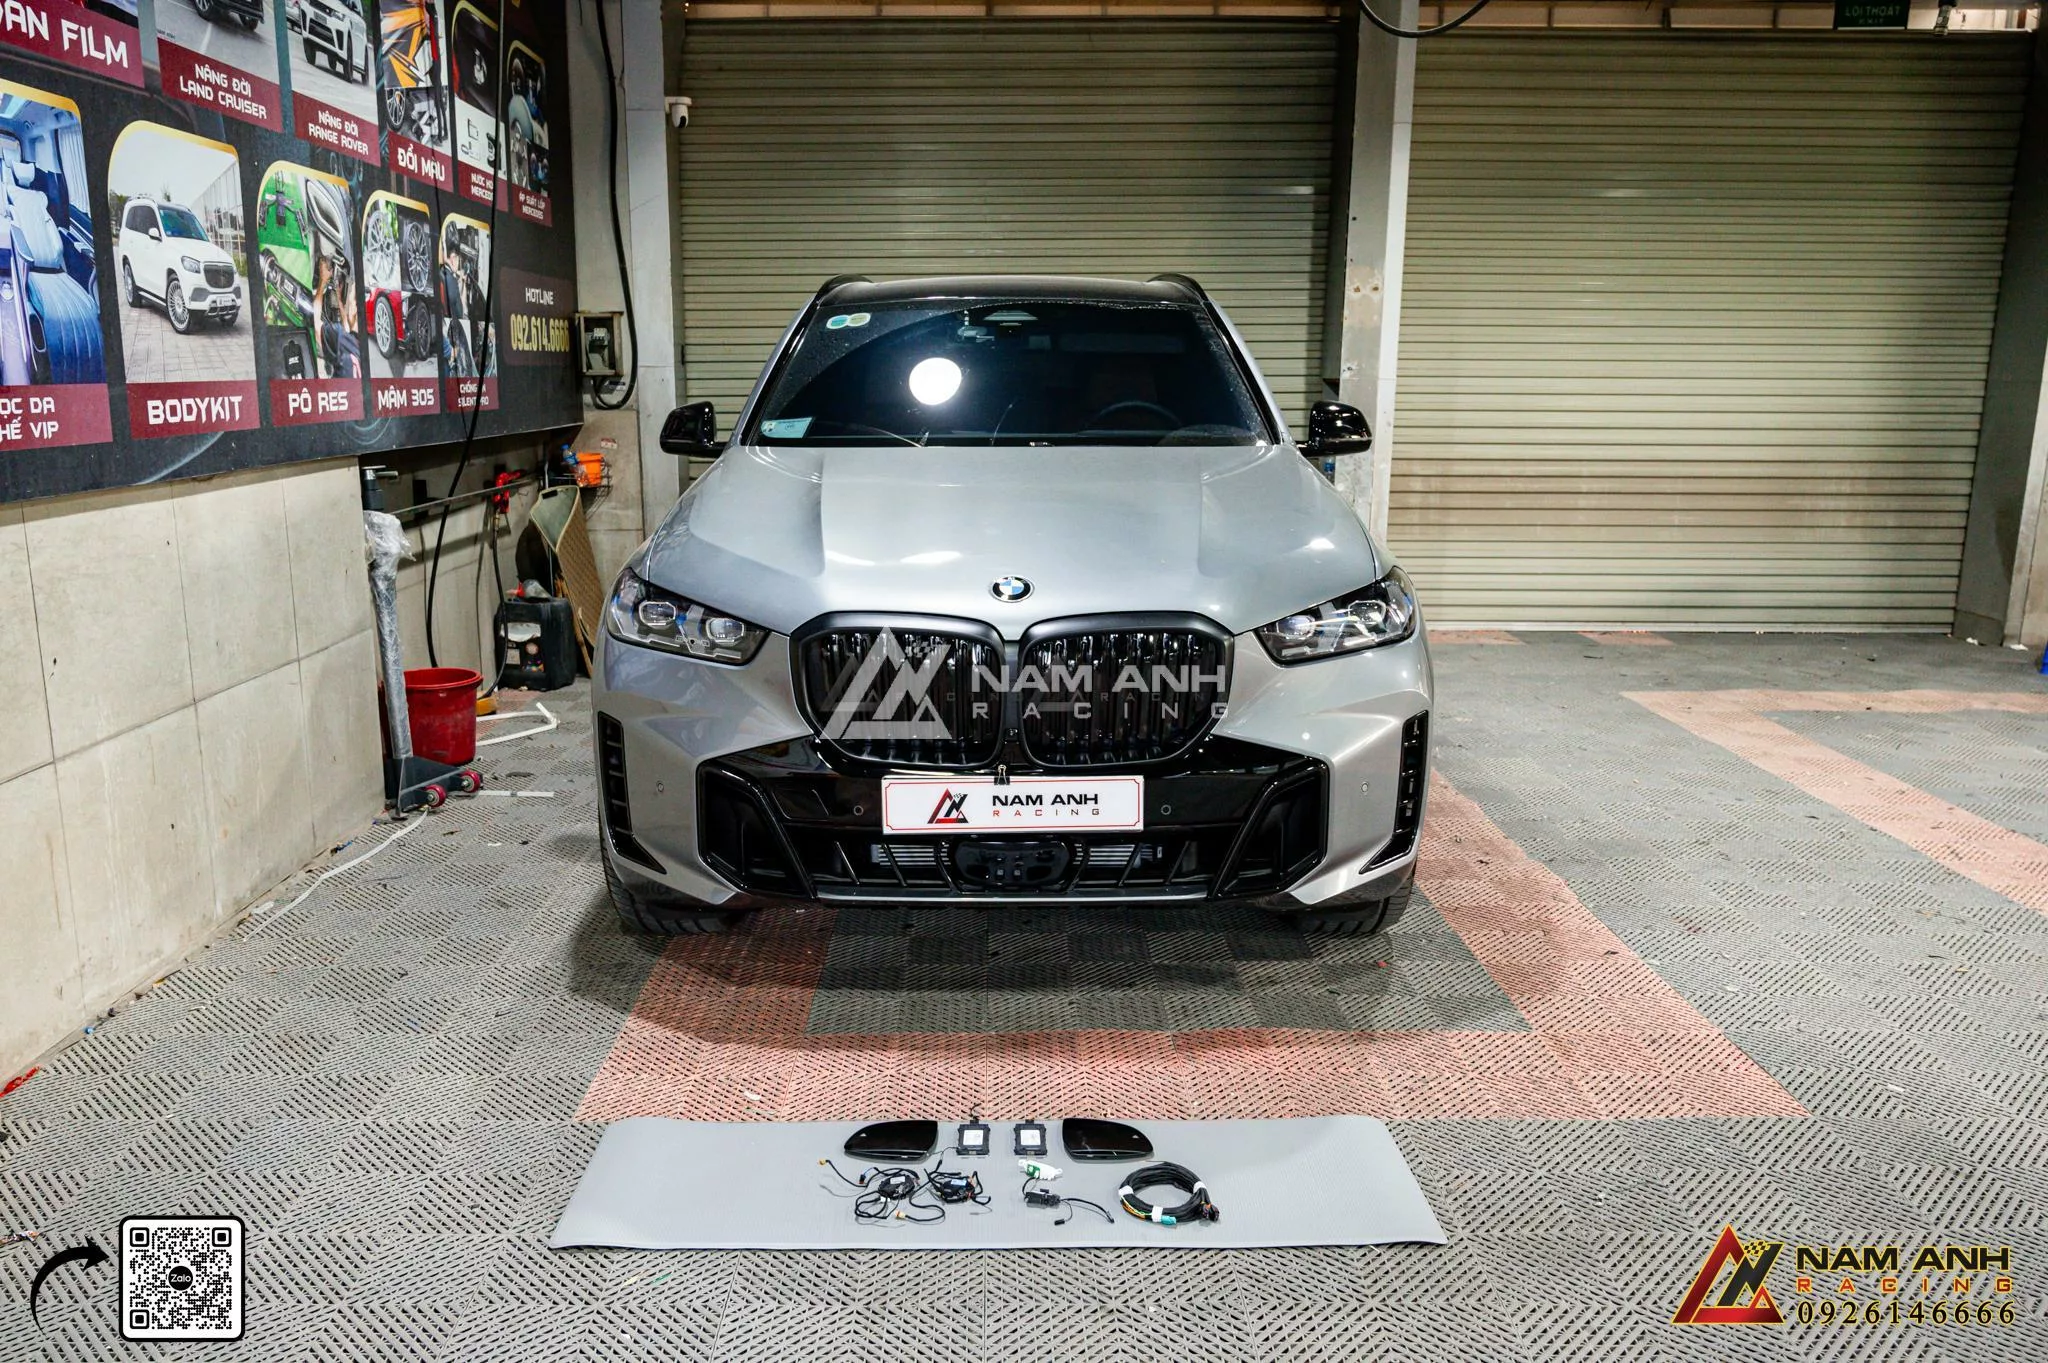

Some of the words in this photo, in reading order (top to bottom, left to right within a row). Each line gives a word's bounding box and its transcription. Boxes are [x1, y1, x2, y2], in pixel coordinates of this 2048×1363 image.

[61, 18, 129, 69] FILM
[194, 63, 228, 88] NÂNG
[179, 75, 214, 101] LAND
[218, 90, 267, 119] CRUISER
[318, 110, 342, 130] NÂNG
[308, 123, 339, 144] RANGE
[341, 136, 369, 155] ROVER
[397, 144, 418, 173] ĐỔI
[525, 287, 554, 306] HOTLINE
[510, 313, 570, 352] 092.614.6666
[0, 397, 24, 419] ỌC
[29, 396, 56, 415] DA
[146, 395, 243, 425] BODYKIT
[288, 387, 313, 416] PÔ
[317, 391, 349, 415] RES
[377, 385, 408, 411] MÂM
[0, 416, 23, 442] HẾ
[29, 421, 59, 440] VIP
[992, 794, 1044, 807] NAM
[1051, 793, 1099, 806] ANH
[992, 808, 1100, 817] RACING
